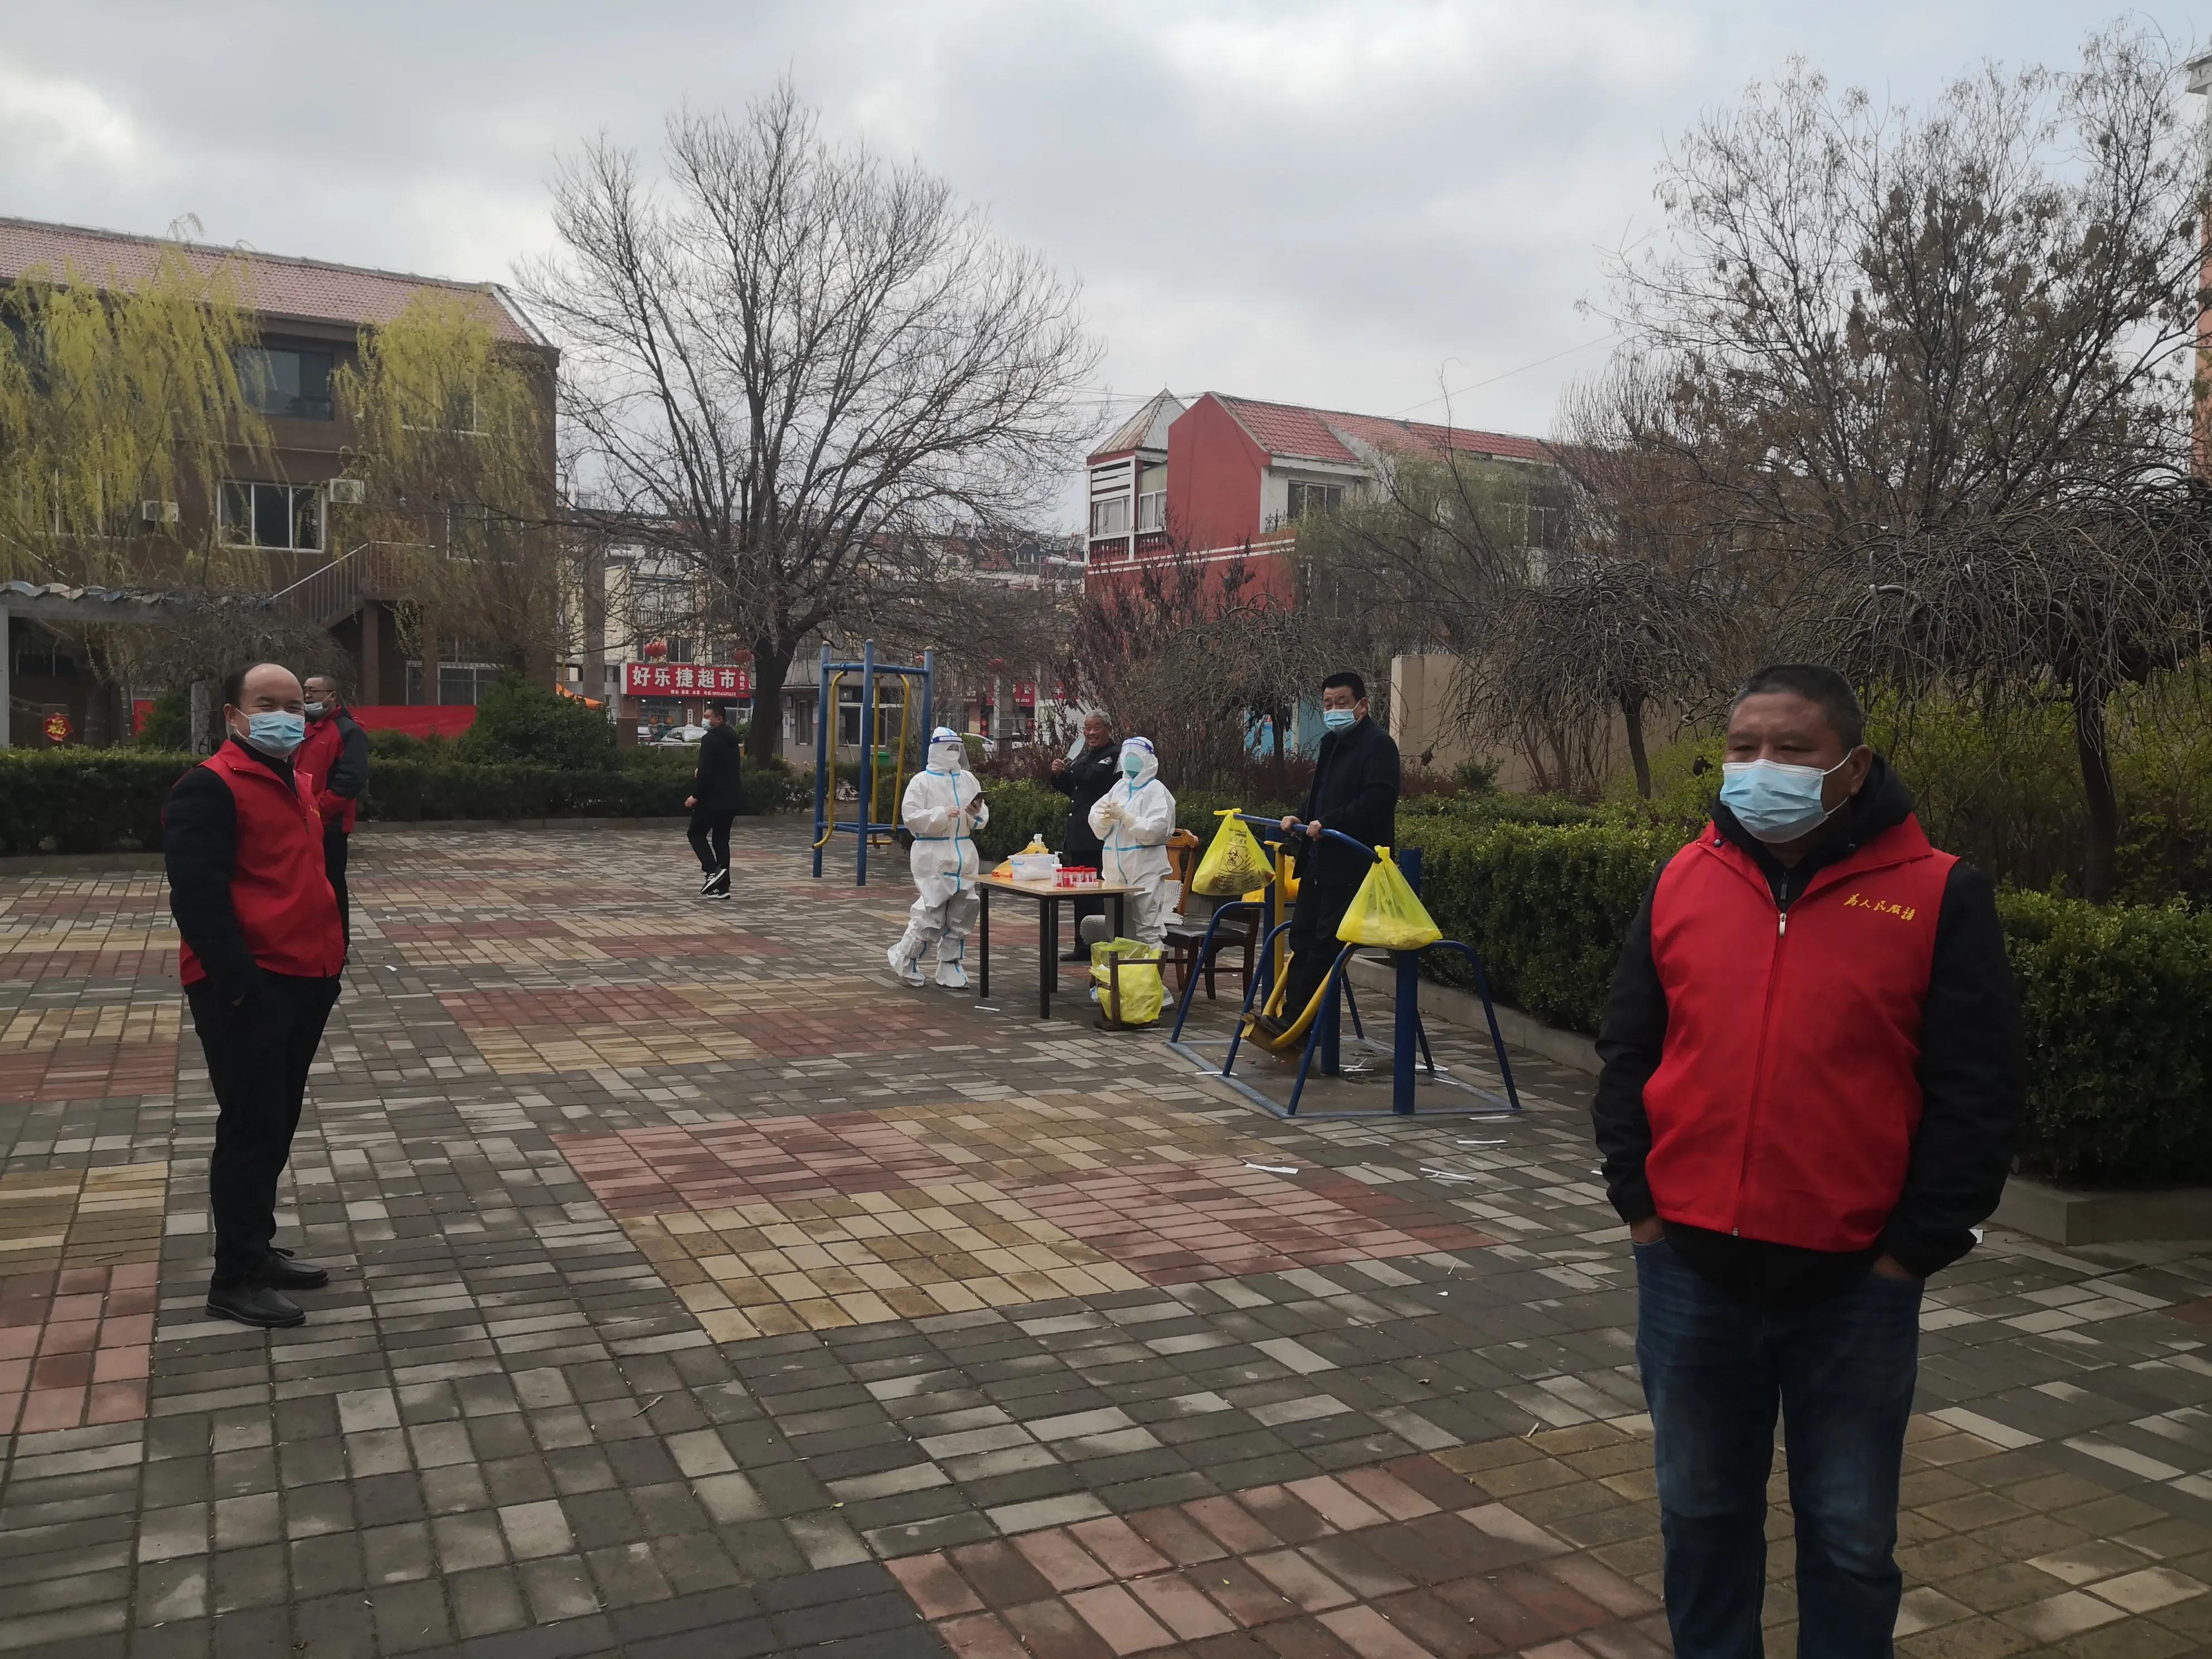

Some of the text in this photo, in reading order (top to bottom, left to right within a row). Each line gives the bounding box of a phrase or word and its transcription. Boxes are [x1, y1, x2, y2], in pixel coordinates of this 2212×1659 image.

[632, 666, 736, 689] 好乐捷超市
